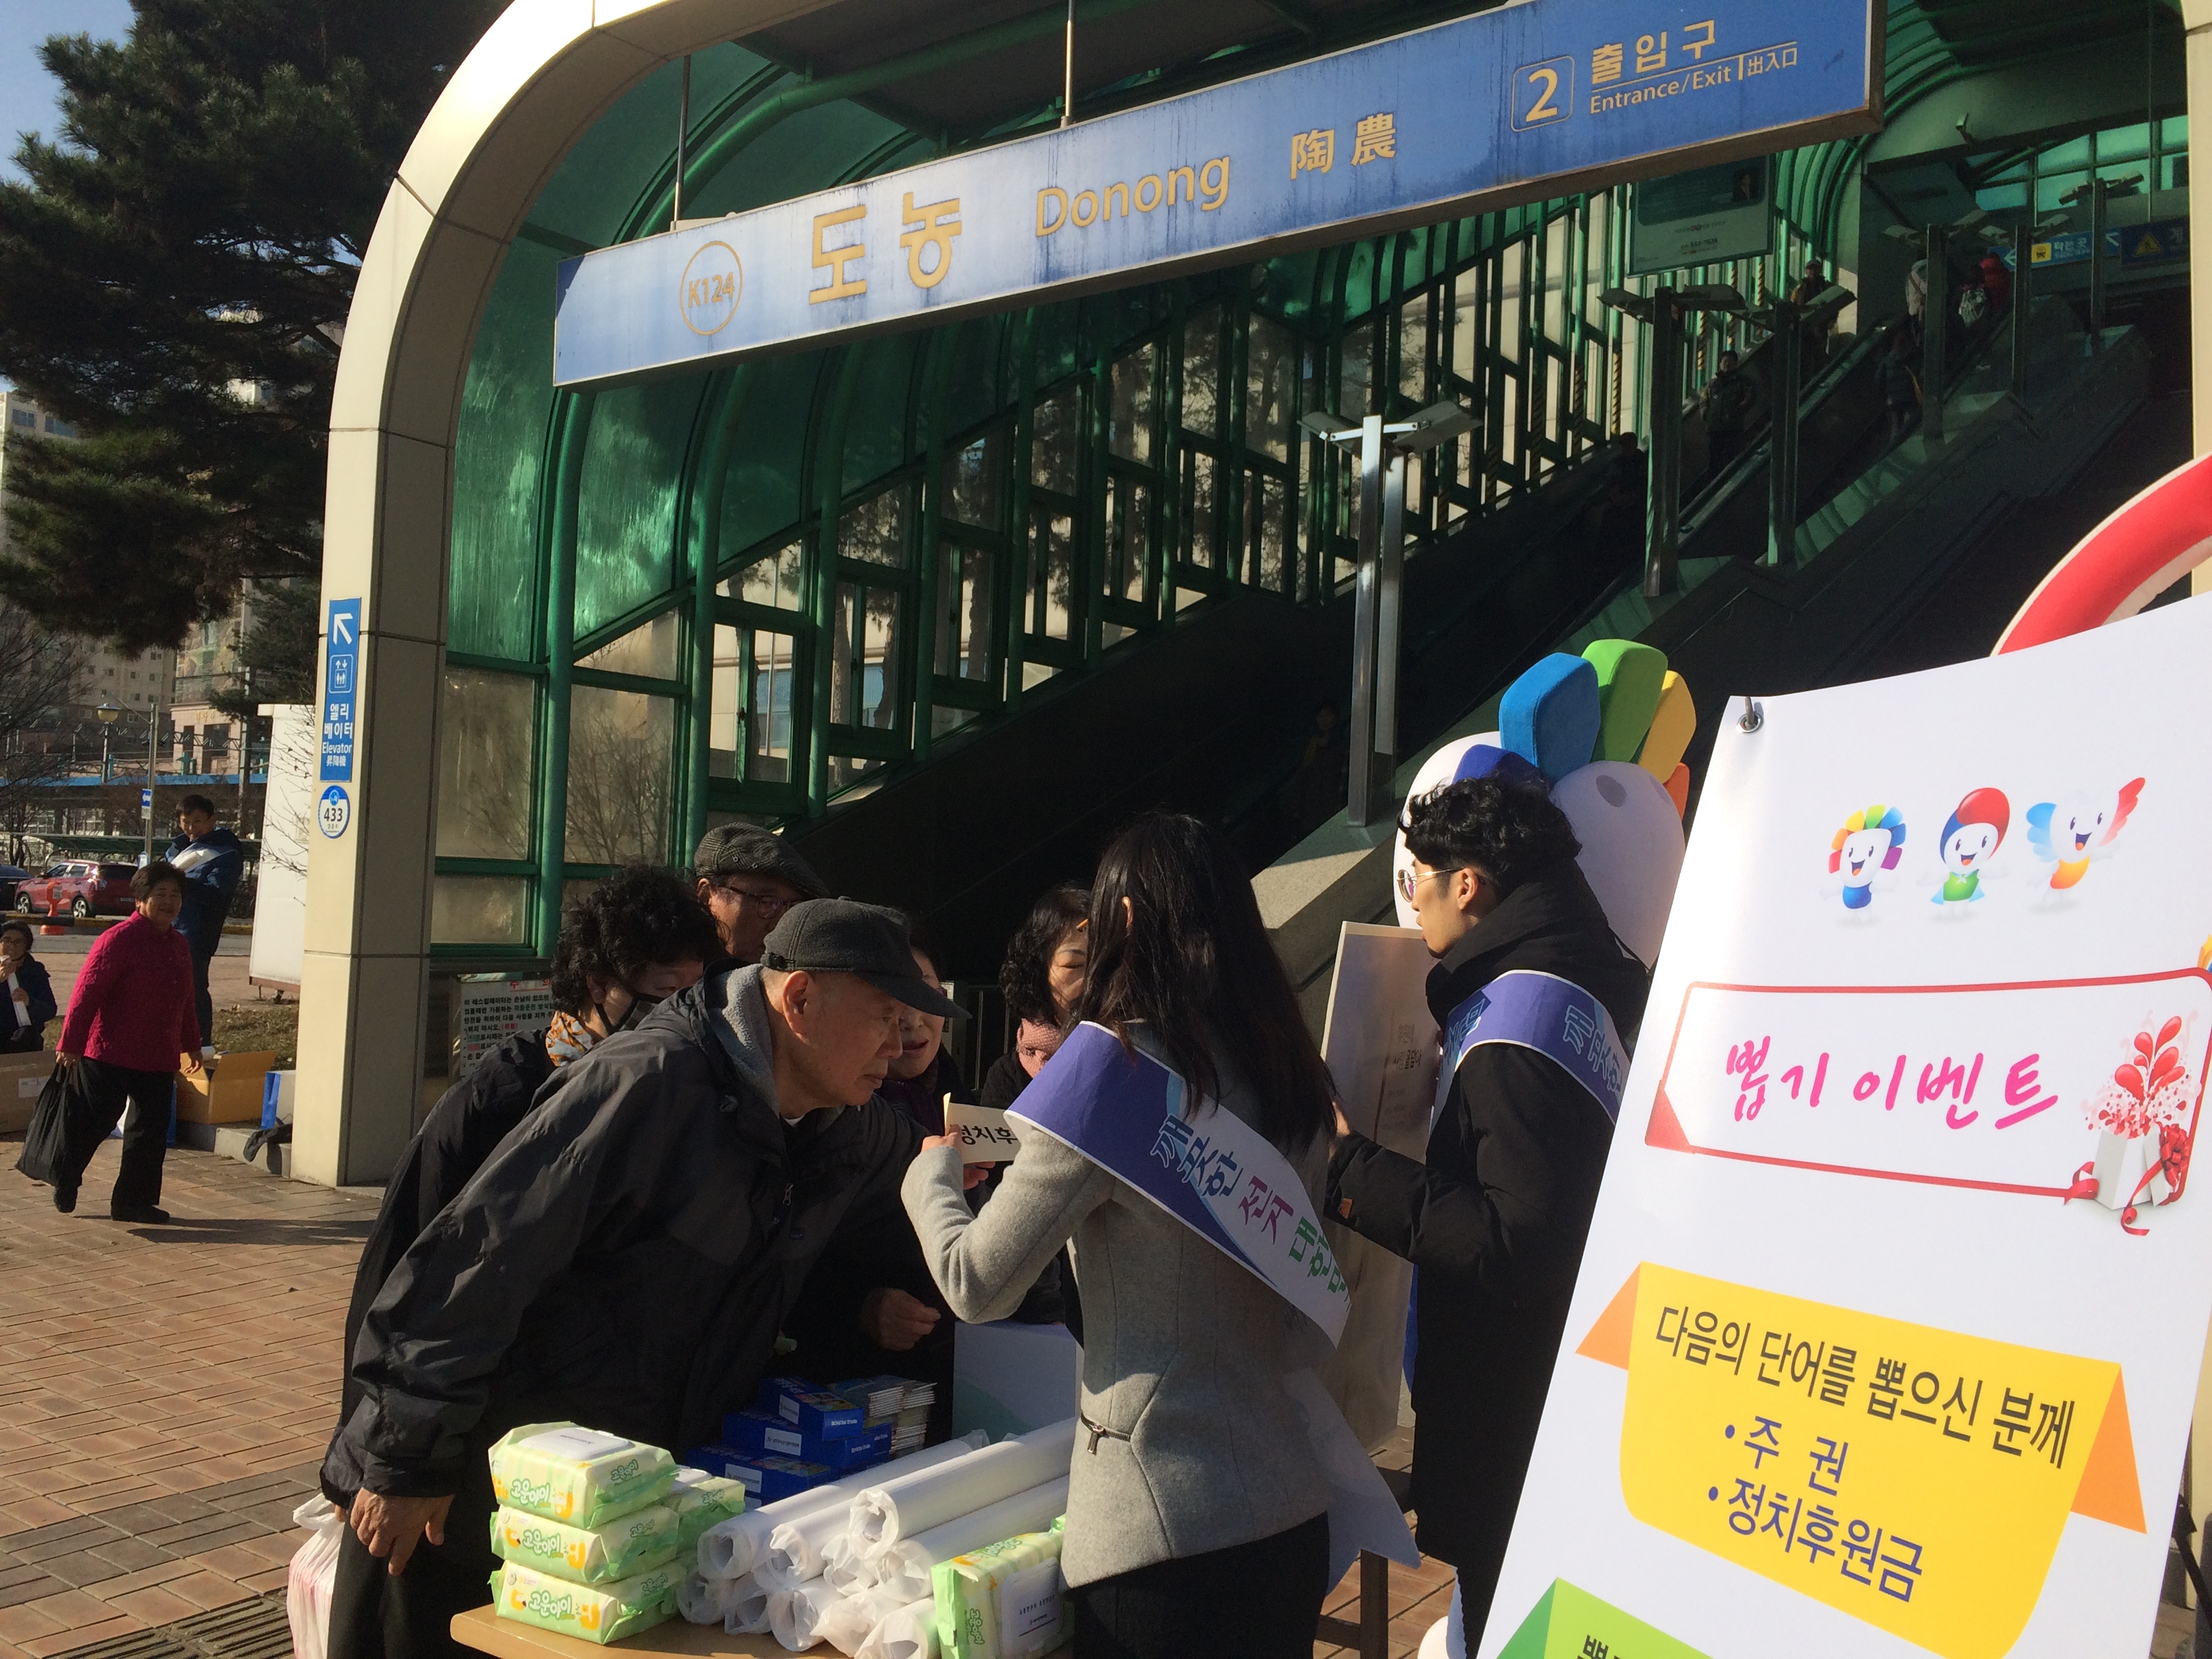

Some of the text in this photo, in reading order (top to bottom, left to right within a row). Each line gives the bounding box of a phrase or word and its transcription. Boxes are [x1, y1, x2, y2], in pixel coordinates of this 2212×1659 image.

[1592, 20, 1715, 84] 출입구
[1747, 47, 1797, 77] 出入口
[1525, 68, 1559, 123] 2
[1590, 65, 1732, 115] Entrance/Exit
[1290, 112, 1398, 180] 陶農
[1036, 156, 1231, 237] Donong
[808, 192, 962, 306] 도농
[687, 268, 735, 308] K124
[324, 722, 352, 739] 베이터
[330, 703, 349, 720] 엘리
[322, 741, 352, 754] Elevator
[324, 807, 343, 822] 433
[1726, 1036, 2058, 1130] 뽑기 이벤트
[1150, 1113, 1244, 1197] 깨끗한
[1654, 1305, 2076, 1470] 다음의 단어를 뽑으신 분께
[510, 1478, 550, 1509] 고운아이
[522, 1528, 561, 1559] 고운아이
[1727, 1477, 1925, 1604] 정치후원금
[527, 1590, 573, 1620] 고운아이
[969, 1607, 985, 1645] 고운아이
